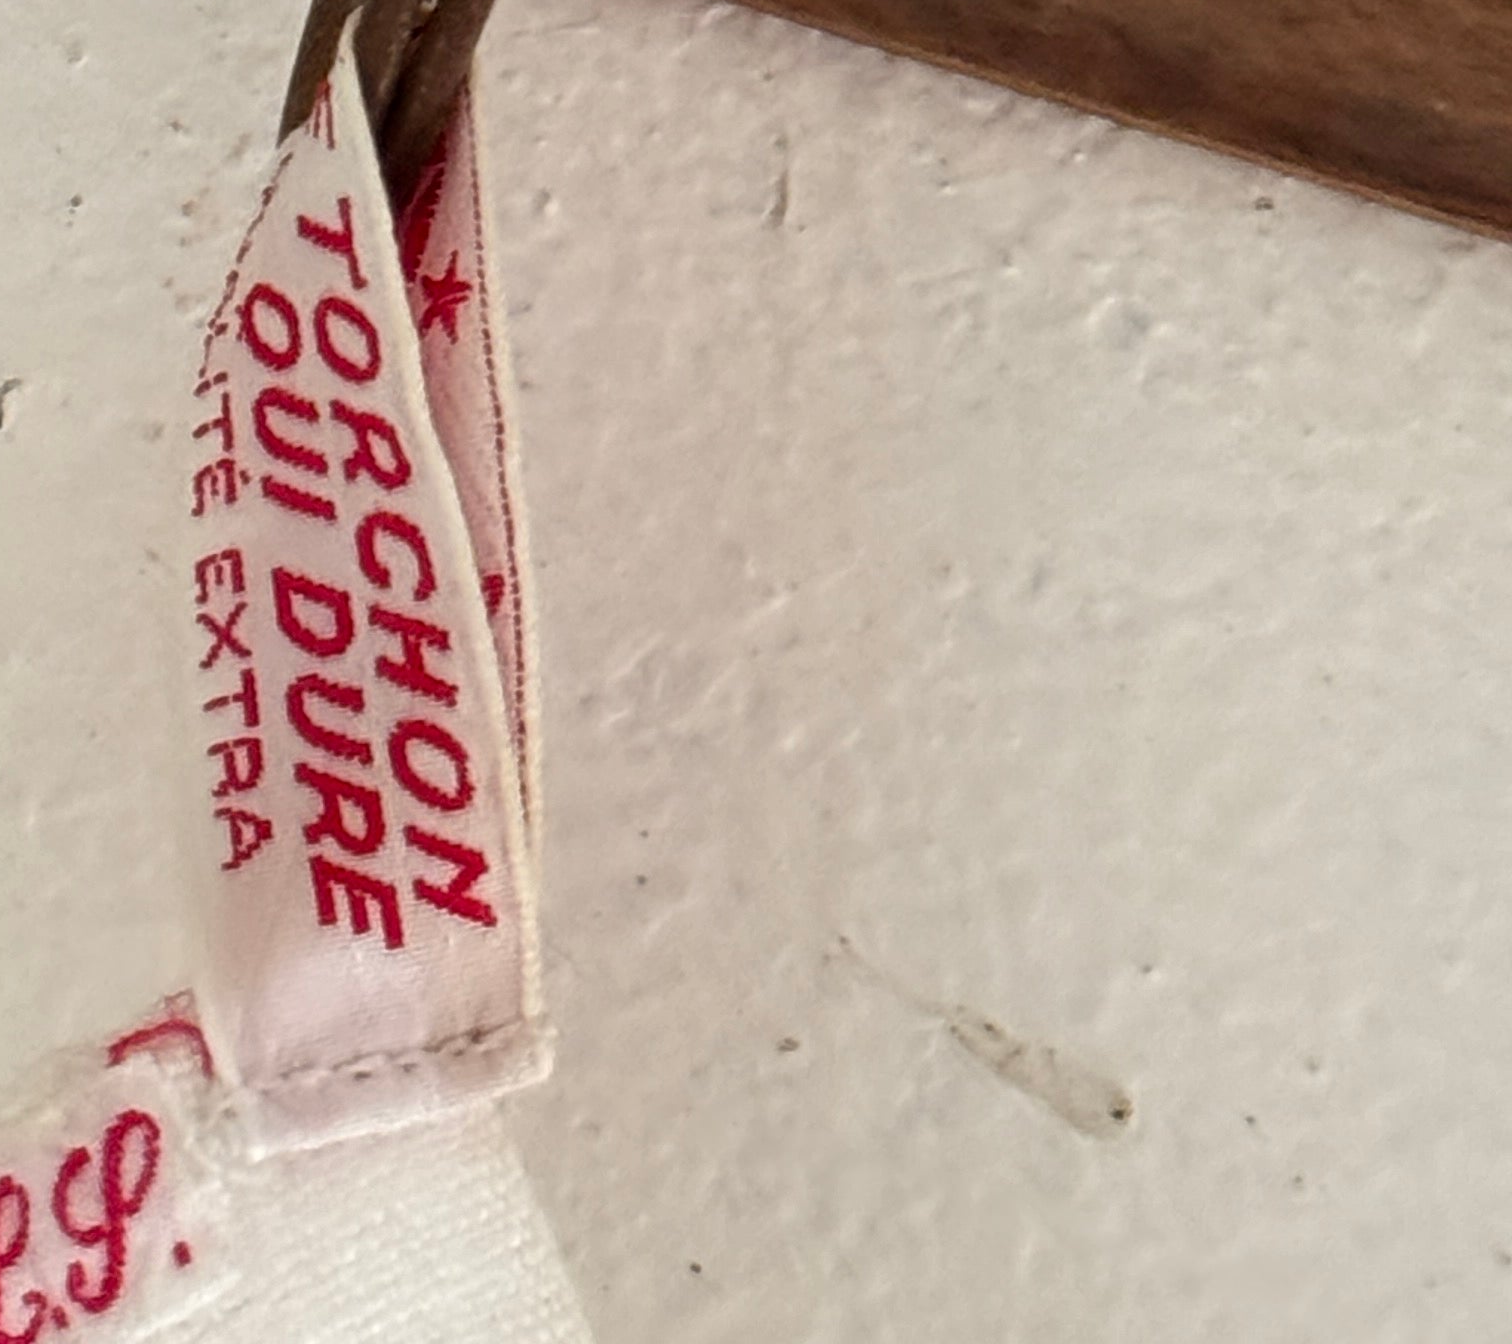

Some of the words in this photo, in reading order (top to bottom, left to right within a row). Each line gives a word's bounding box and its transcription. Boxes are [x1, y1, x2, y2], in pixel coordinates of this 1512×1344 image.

[193, 547, 274, 872] EXTRA
[296, 195, 498, 928] TORCHON
[270, 565, 405, 951] DURE
